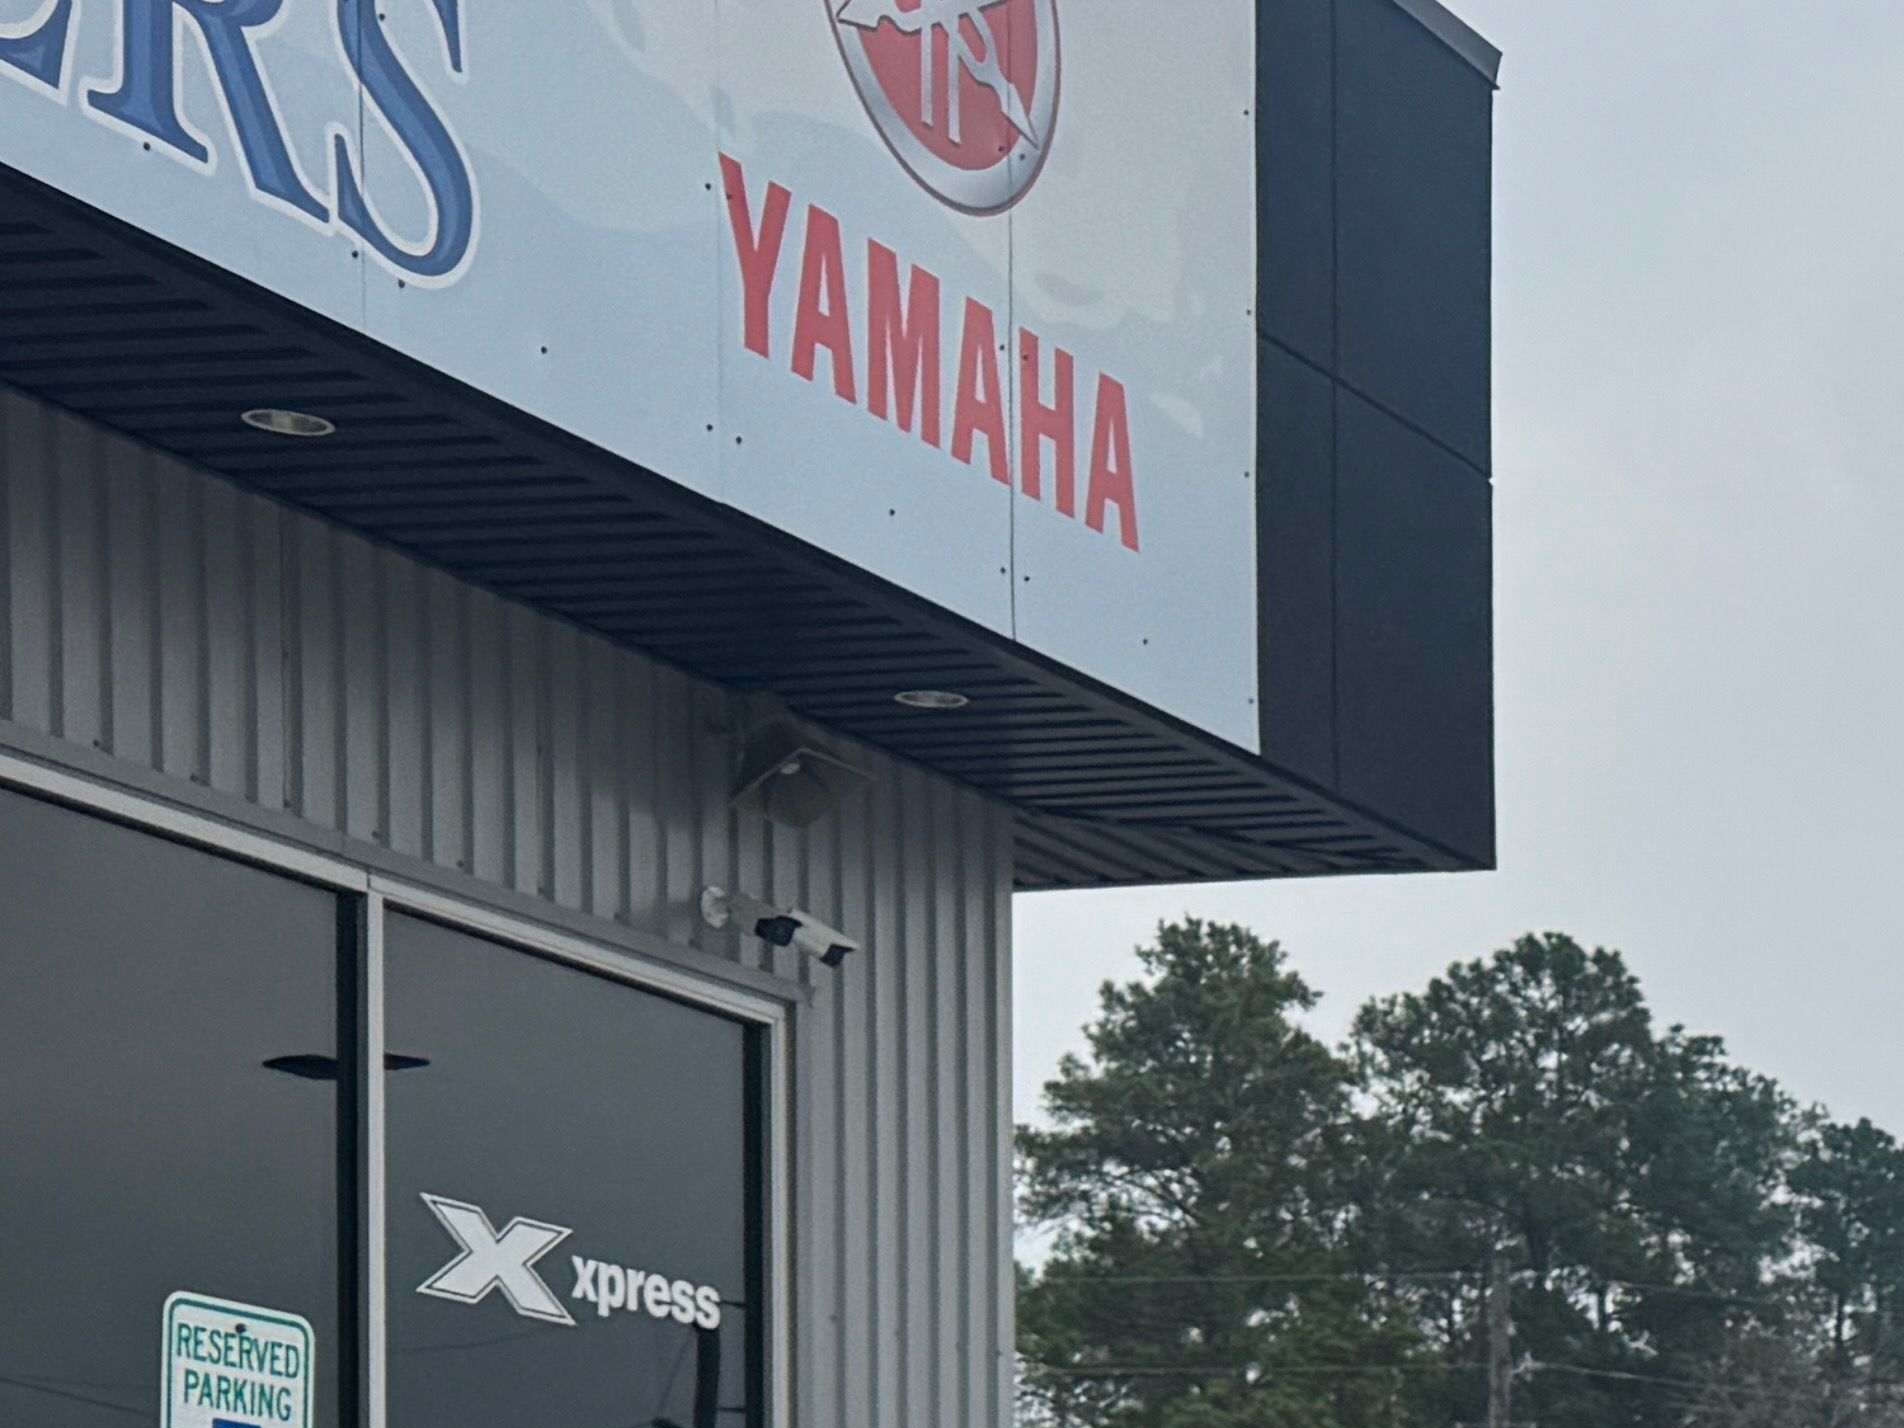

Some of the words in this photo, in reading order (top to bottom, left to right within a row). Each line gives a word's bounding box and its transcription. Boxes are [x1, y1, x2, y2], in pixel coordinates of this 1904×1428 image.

[0, 0, 478, 283] RS
[717, 151, 1140, 553] YAMAHA
[571, 1255, 720, 1329] xpress
[177, 1323, 300, 1379] RESERVED
[184, 1369, 292, 1421] PARKING
